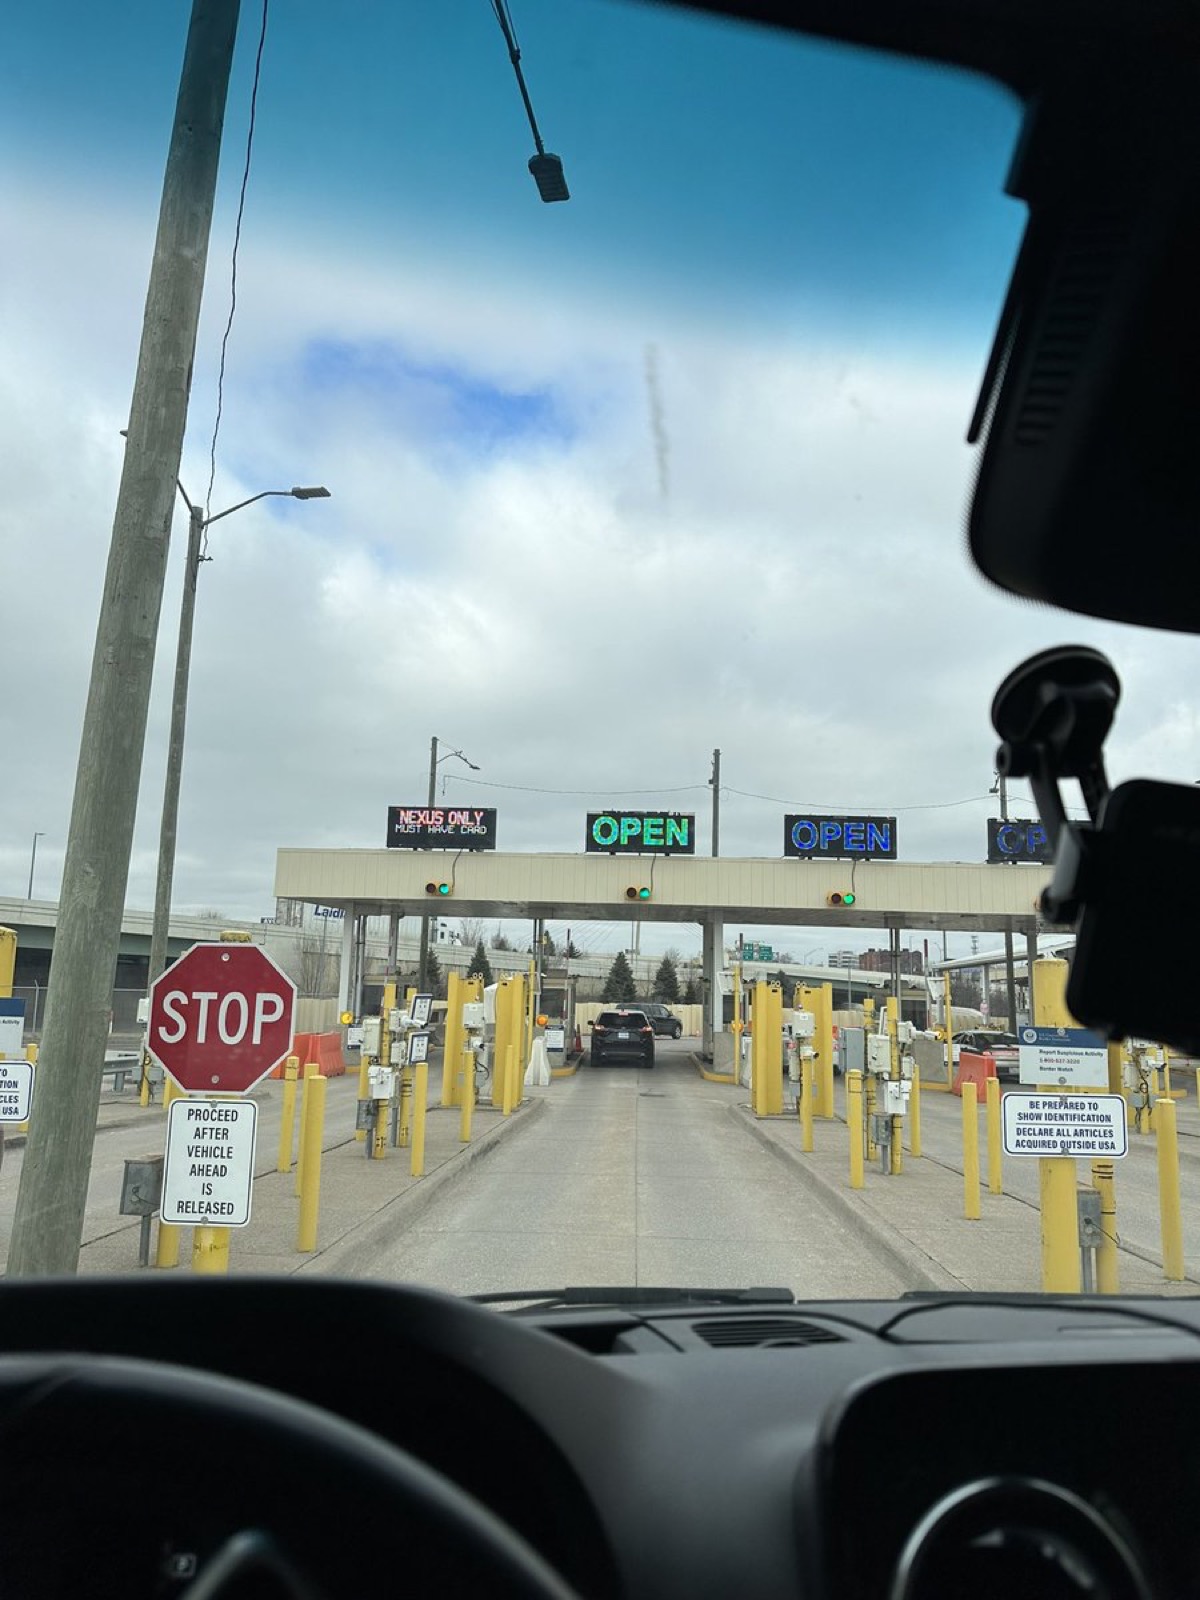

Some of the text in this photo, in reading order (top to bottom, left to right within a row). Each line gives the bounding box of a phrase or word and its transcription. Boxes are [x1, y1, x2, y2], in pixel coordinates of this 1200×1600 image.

[400, 810, 484, 826] NEXUS ONLY
[395, 823, 487, 835] MUST HAVE CARD
[592, 815, 688, 847] OPEN
[791, 819, 890, 851] OPEN
[158, 989, 285, 1045] STOP
[2, 1106, 19, 1116] USA
[1029, 1100, 1099, 1111] BE PREPARED TO
[187, 1108, 239, 1122] PROCEED
[1017, 1112, 1112, 1123] SHOW IDENTIFICATION
[193, 1127, 229, 1141] AFTER
[1016, 1127, 1114, 1139] DECLARE ALL ARTICLES
[1015, 1139, 1116, 1151] ACQUIRED OUTSIDE USA
[187, 1145, 233, 1160] VEHICLE
[189, 1164, 228, 1178] AHEAD
[202, 1182, 213, 1196] IS
[176, 1200, 234, 1215] RELEASED
